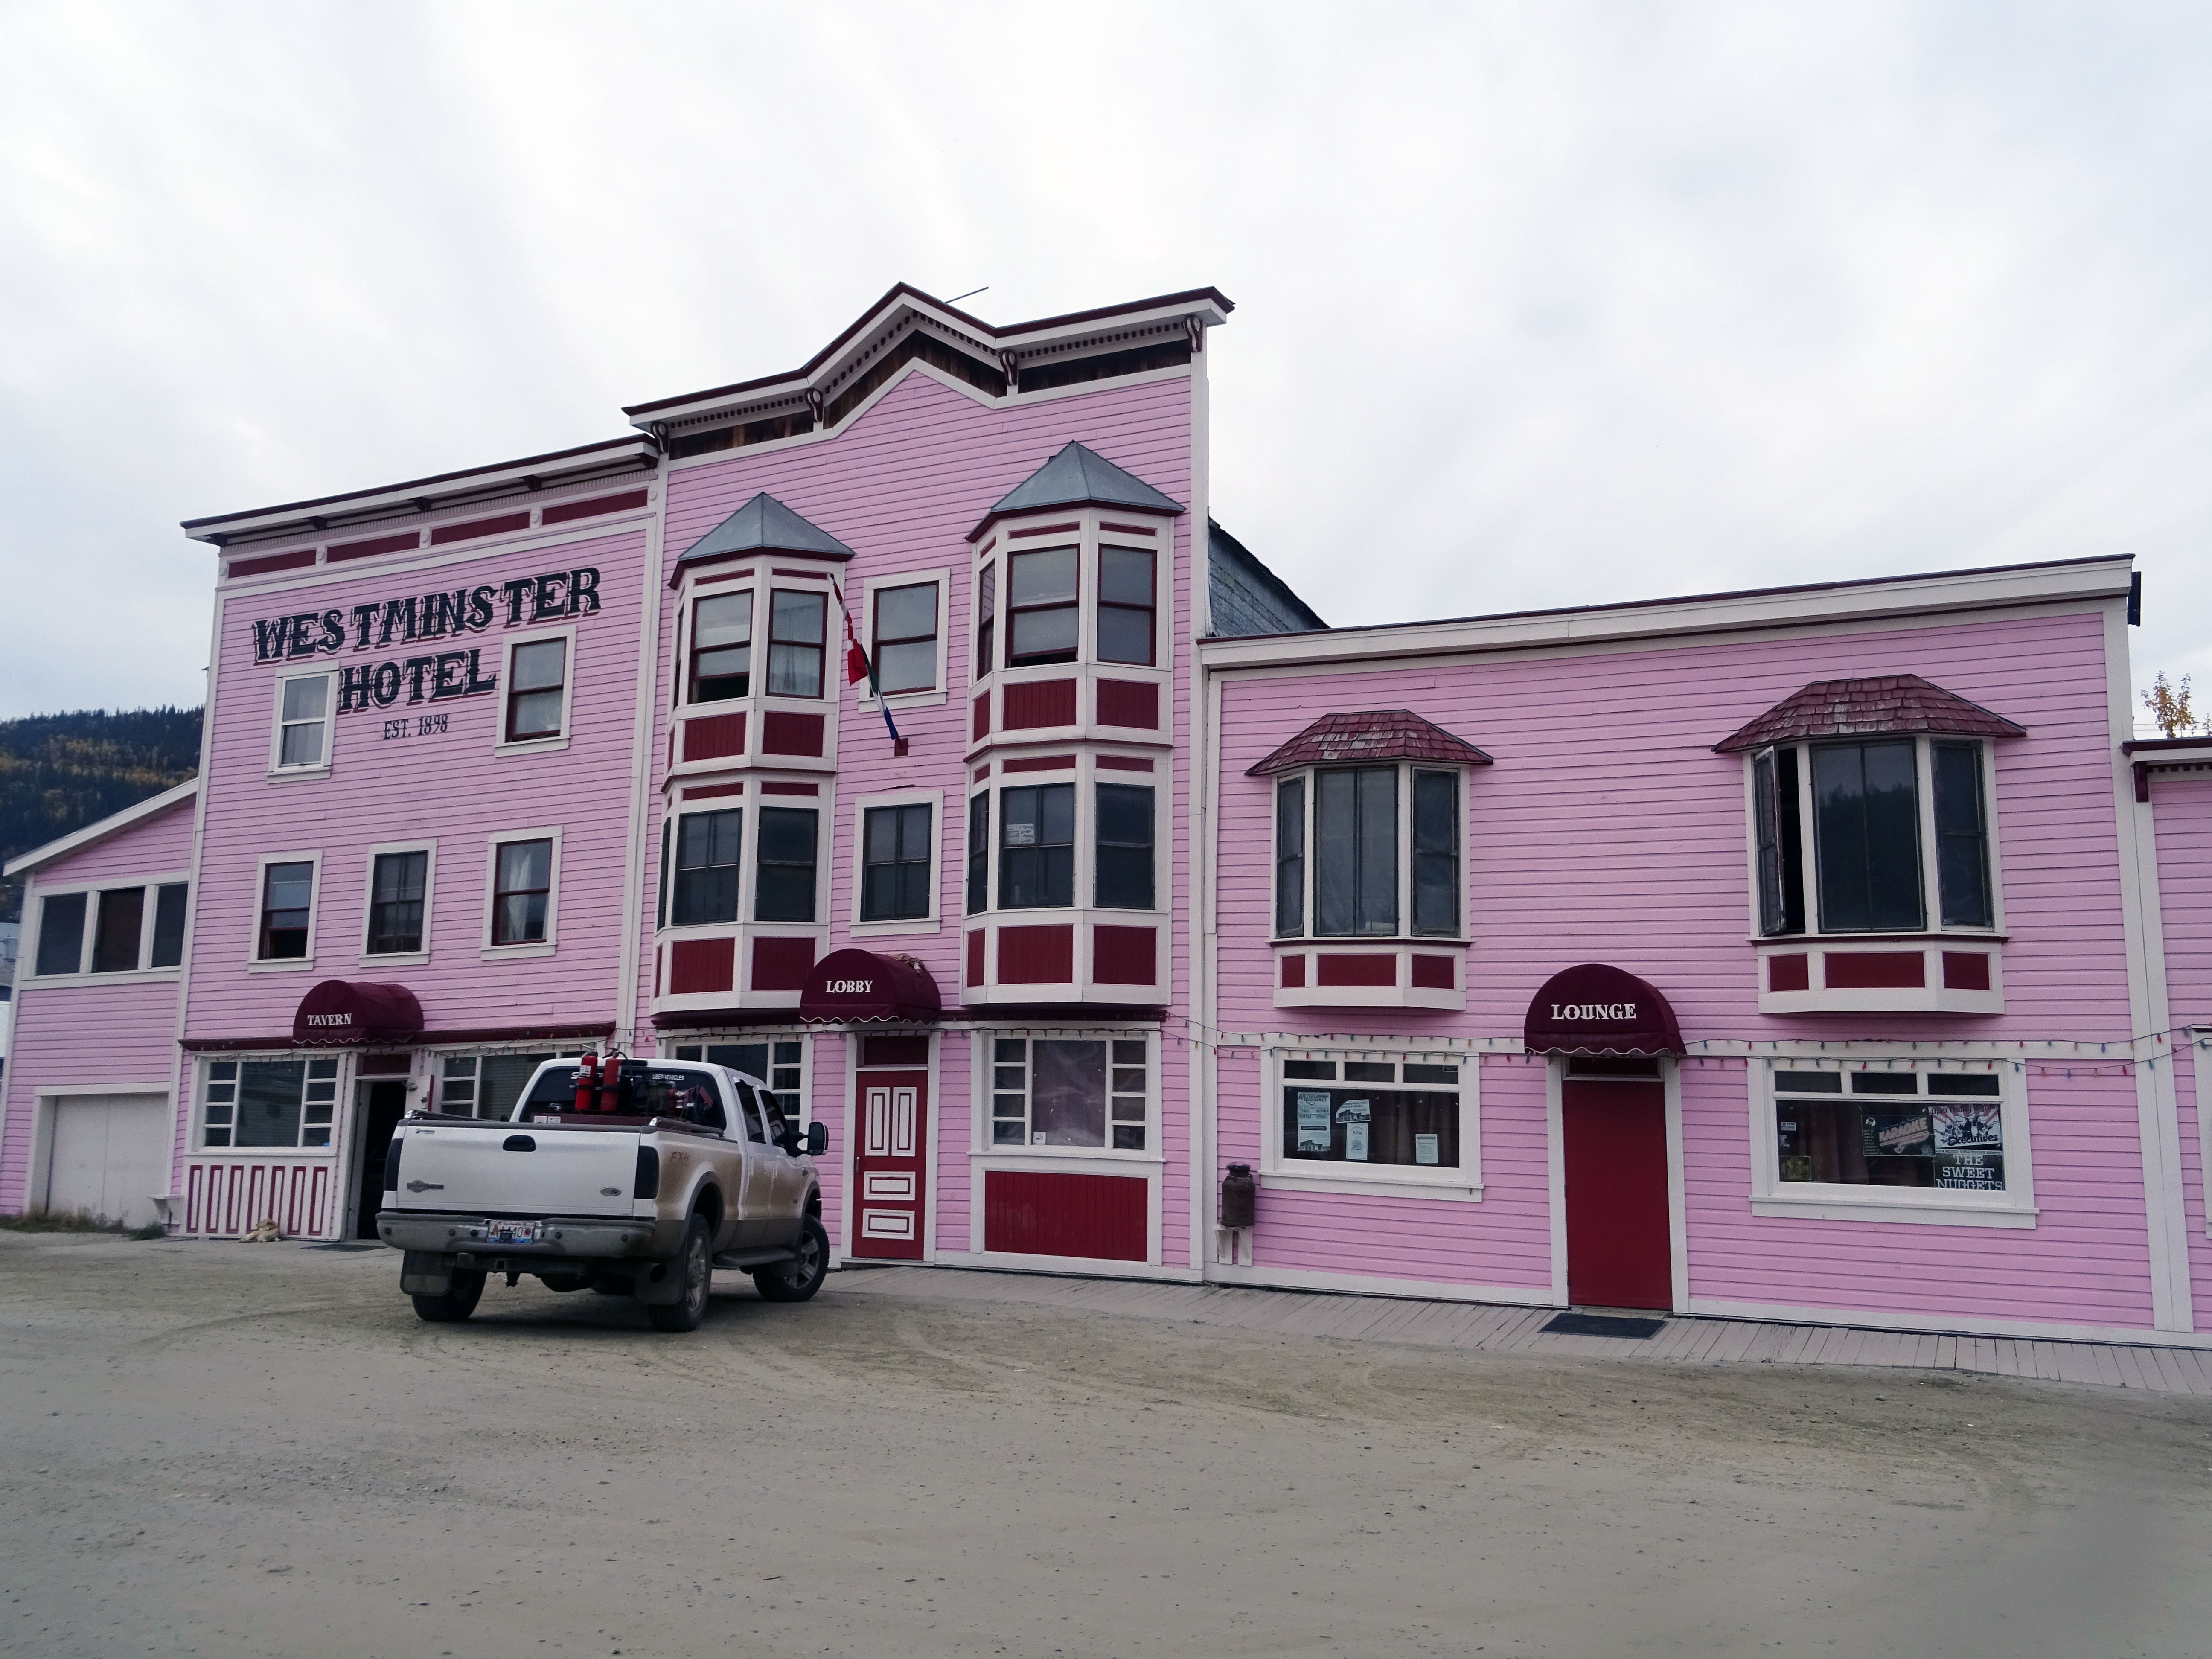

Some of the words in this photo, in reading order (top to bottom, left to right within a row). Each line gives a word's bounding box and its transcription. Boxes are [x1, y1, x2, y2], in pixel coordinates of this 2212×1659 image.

[252, 567, 601, 665] WESTMINSTER
[337, 648, 497, 715] HOTEL
[383, 719, 411, 740] EST.
[417, 714, 448, 735] 1898
[825, 980, 873, 993] LOBBY
[307, 1013, 352, 1025] TAVERN
[1551, 1003, 1636, 1020] LOUNGE
[1879, 1117, 1928, 1142] KARAOKE
[1953, 1155, 1983, 1166] THE
[1942, 1166, 1995, 1179] SWEET
[1936, 1178, 2003, 1190] NUGGETS
